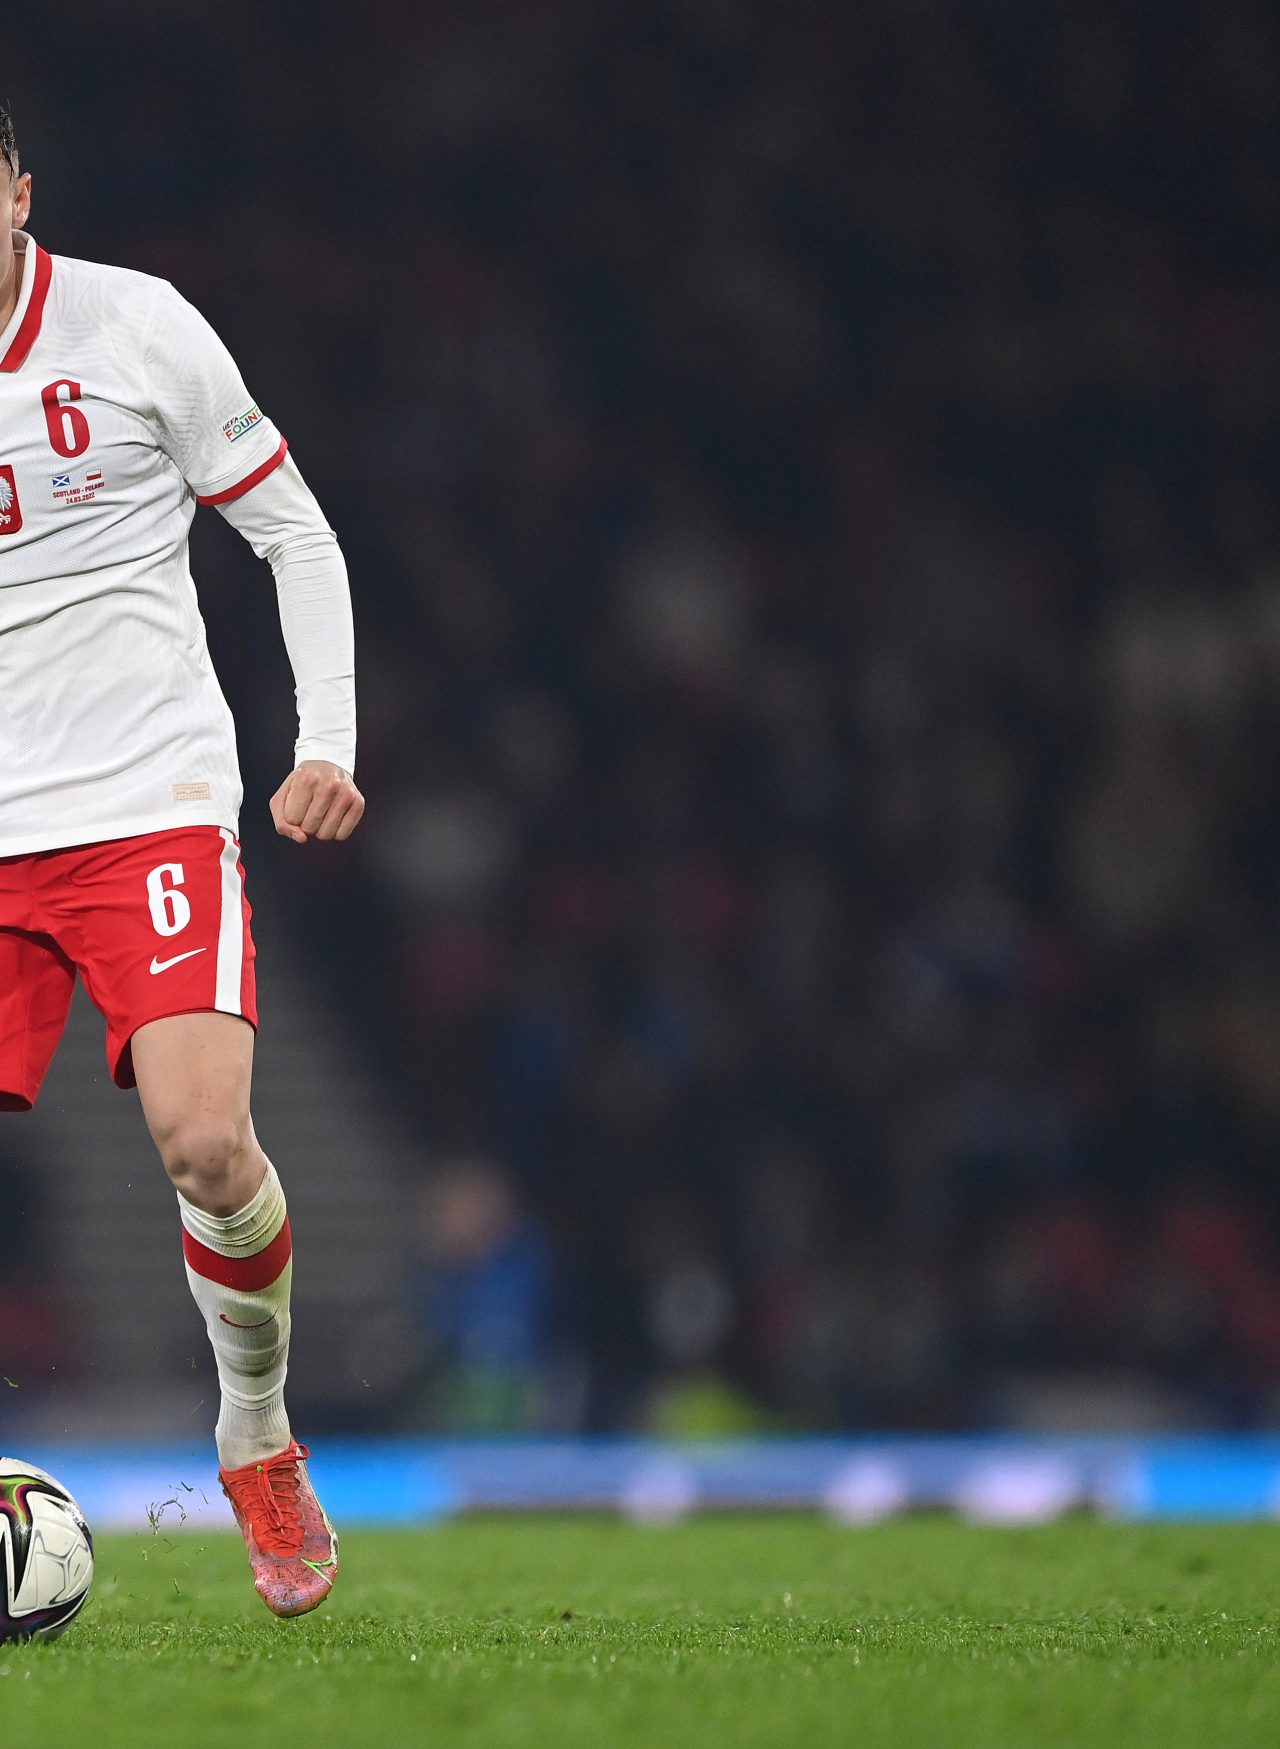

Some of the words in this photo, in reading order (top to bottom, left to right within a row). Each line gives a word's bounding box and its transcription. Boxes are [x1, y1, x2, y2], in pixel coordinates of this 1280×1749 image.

[41, 379, 90, 458] 6
[222, 416, 239, 431] UEFA
[52, 488, 81, 498] SCOTLAND
[146, 862, 191, 937] 6
